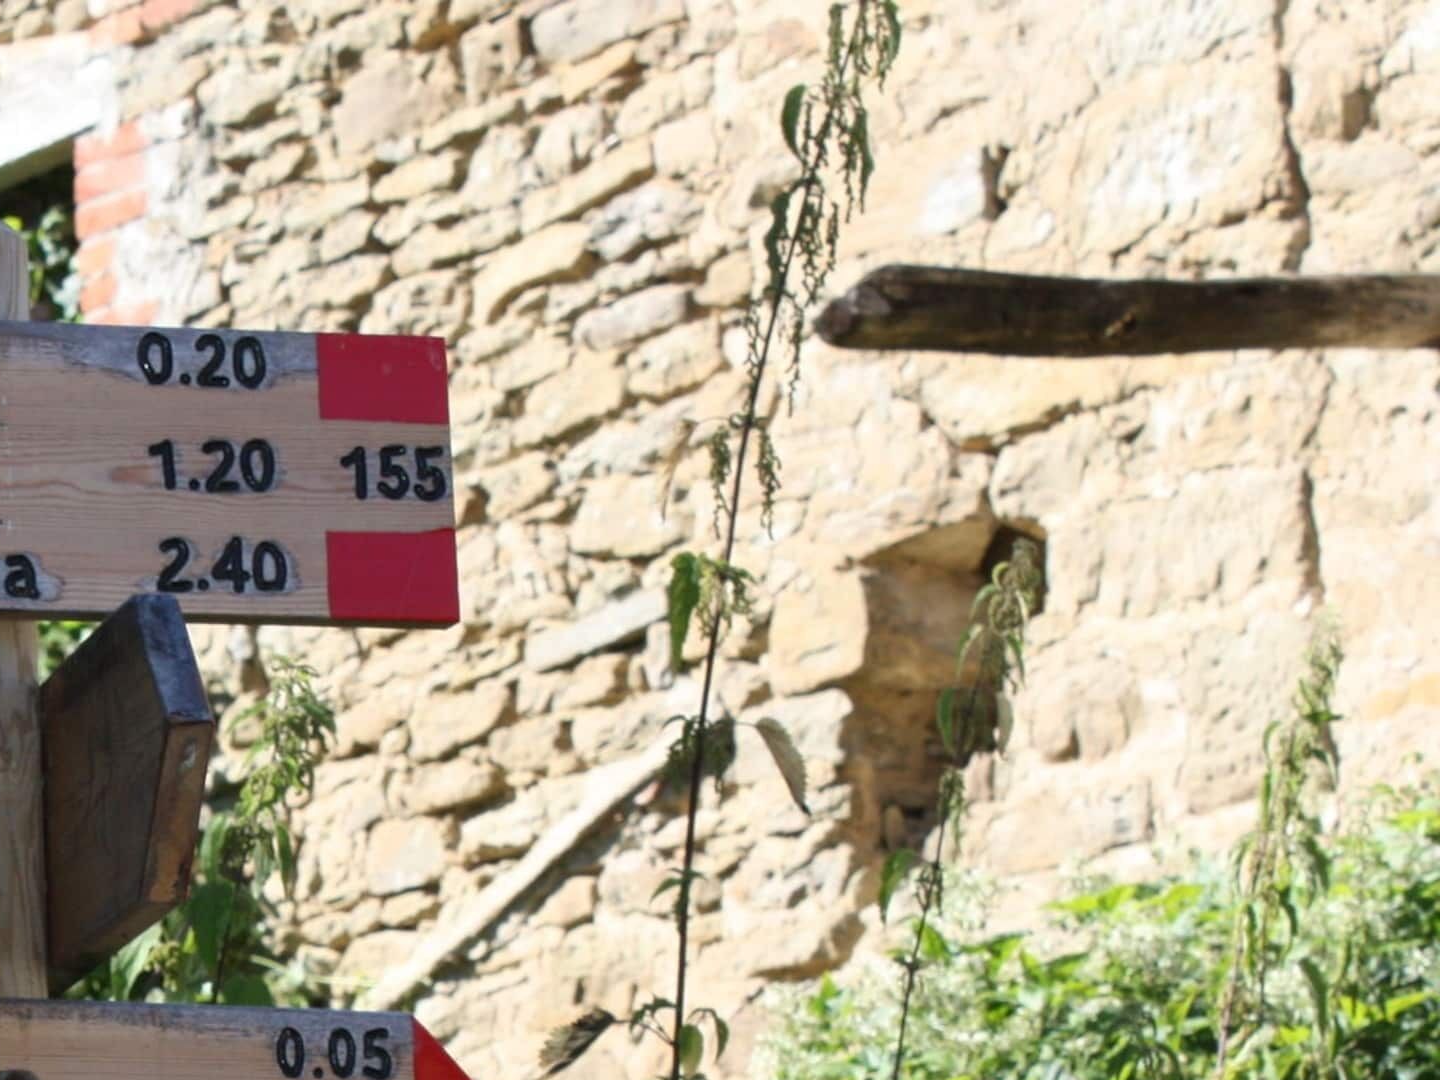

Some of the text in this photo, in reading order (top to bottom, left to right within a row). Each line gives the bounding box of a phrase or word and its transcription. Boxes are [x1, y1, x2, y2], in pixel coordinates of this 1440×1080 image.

[137, 332, 267, 390] 0.20
[147, 437, 275, 493] 1.20
[340, 444, 447, 501] 155
[156, 535, 288, 594] 2.40
[276, 1026, 392, 1080] 0.05
